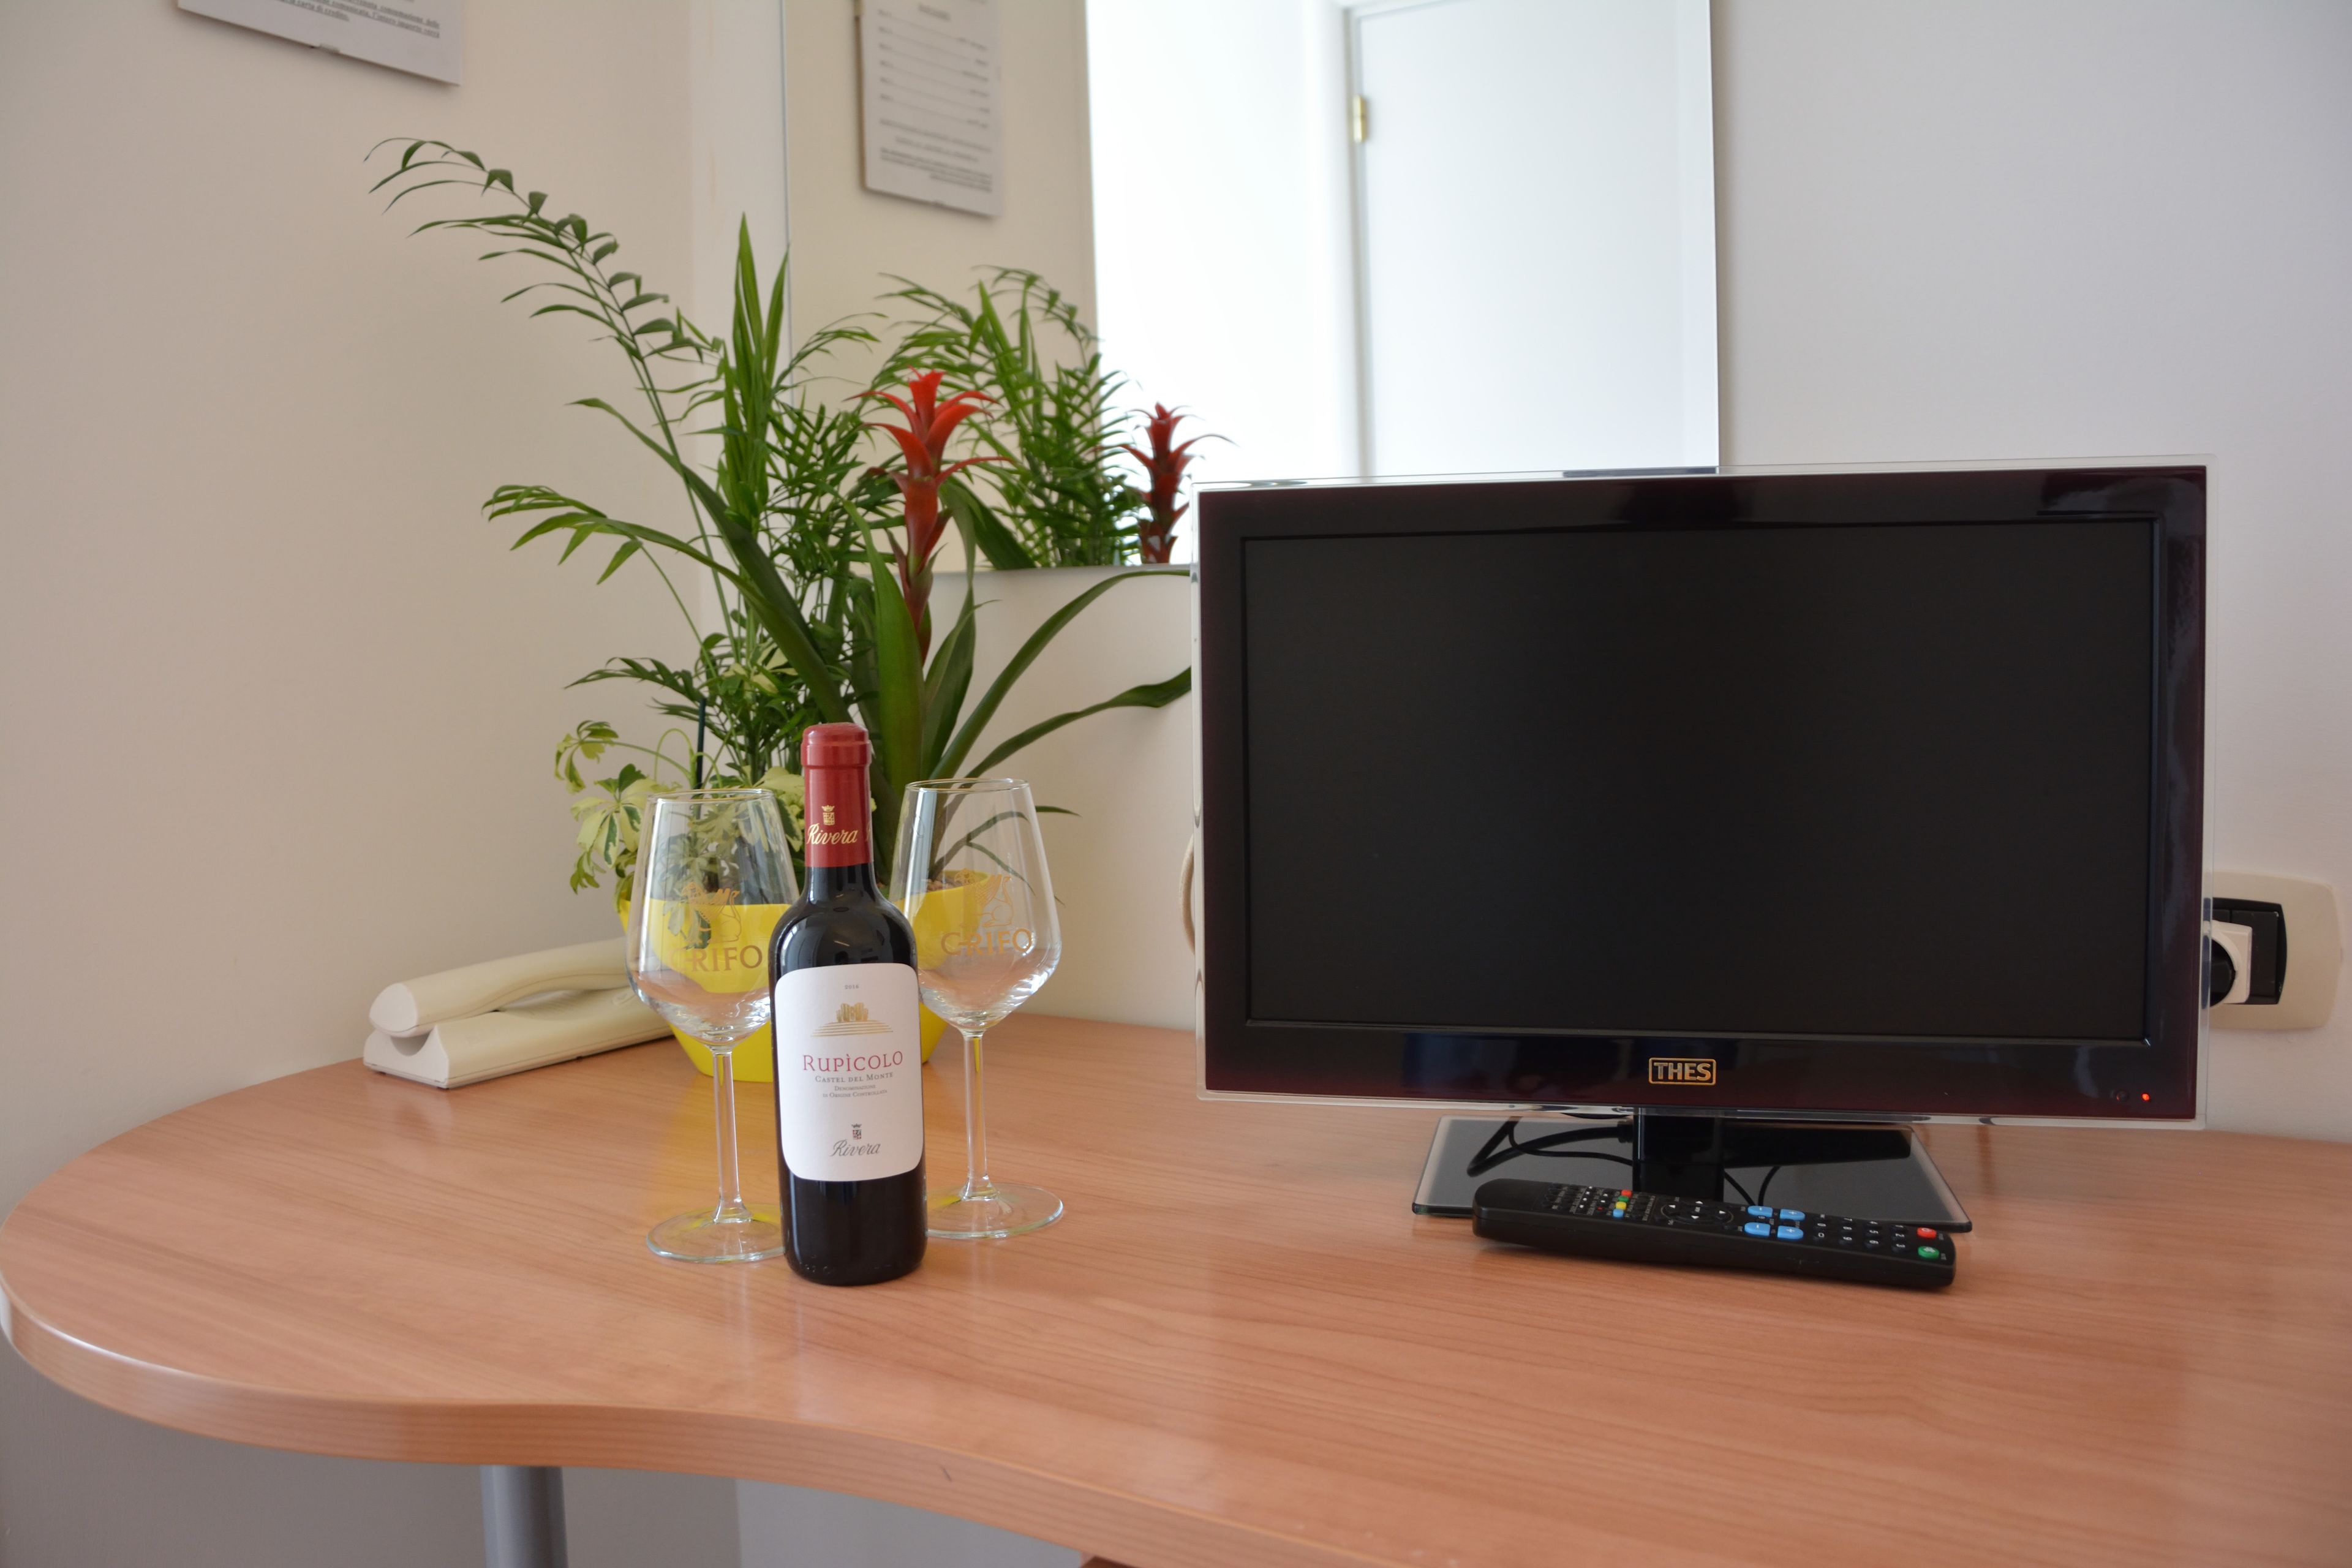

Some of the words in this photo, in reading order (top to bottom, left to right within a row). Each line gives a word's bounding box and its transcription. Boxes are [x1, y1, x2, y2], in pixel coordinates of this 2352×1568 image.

[805, 823, 858, 845] Rivera
[866, 1072, 894, 1081] MONTE
[1653, 1061, 1712, 1082] THES
[829, 1139, 881, 1157] Rivera
